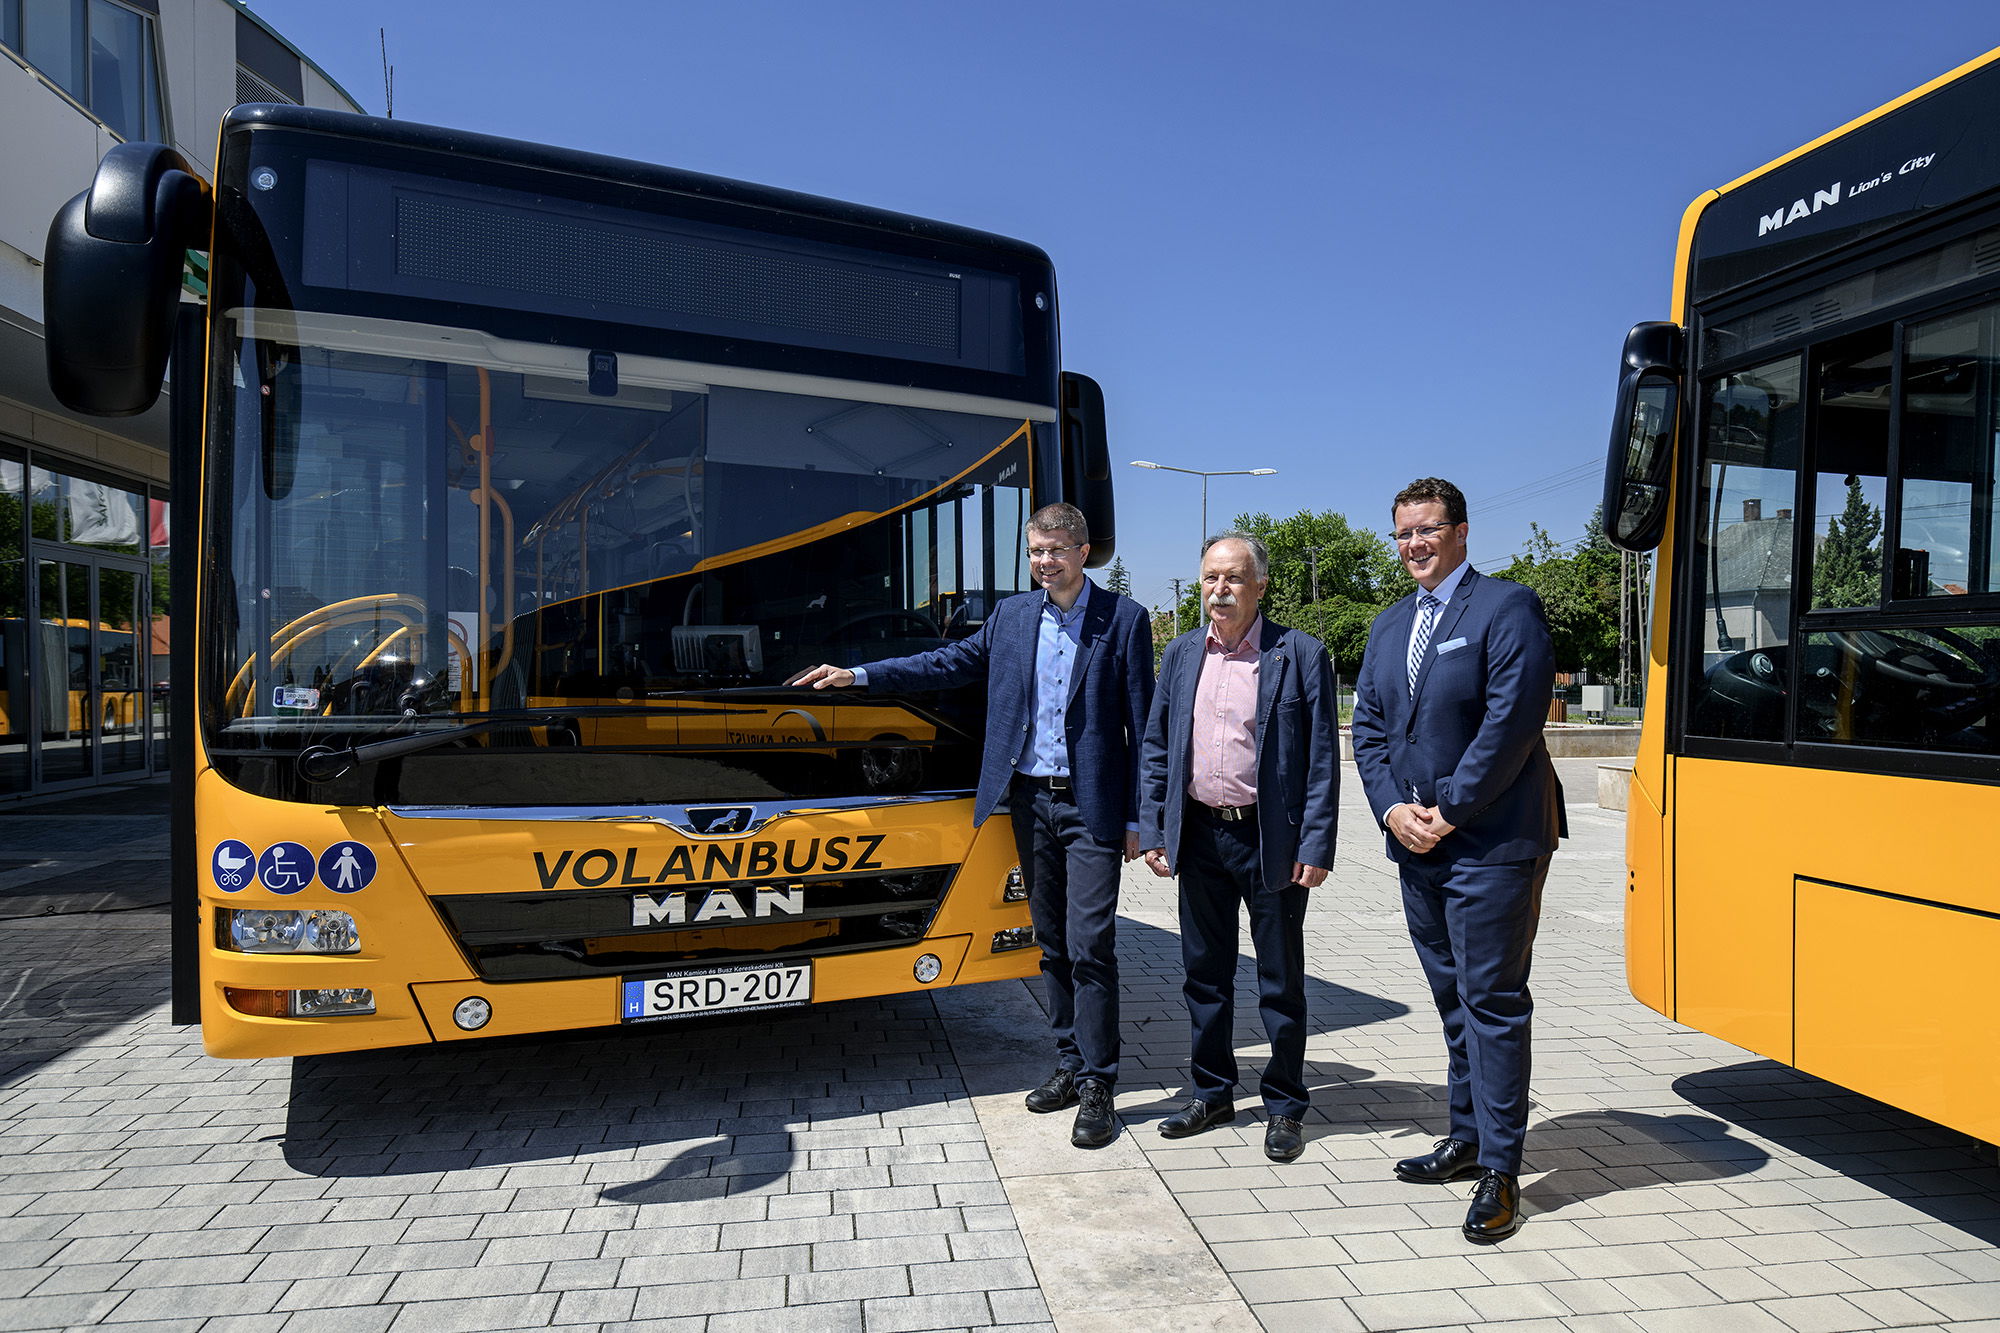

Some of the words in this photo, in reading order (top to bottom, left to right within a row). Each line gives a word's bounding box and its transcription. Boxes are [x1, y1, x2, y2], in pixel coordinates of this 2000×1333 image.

[1758, 181, 1841, 237] MAN
[1849, 172, 1892, 197] Lion's
[1898, 152, 1936, 175] City
[532, 834, 887, 889] VOLÁNBUSZ
[632, 884, 804, 927] MAN
[652, 970, 803, 1012] SRD-207
[684, 969, 708, 977] Kamion
[718, 966, 733, 974] Busz
[734, 963, 774, 972] Kereskedelmi
[629, 1002, 639, 1013] H
